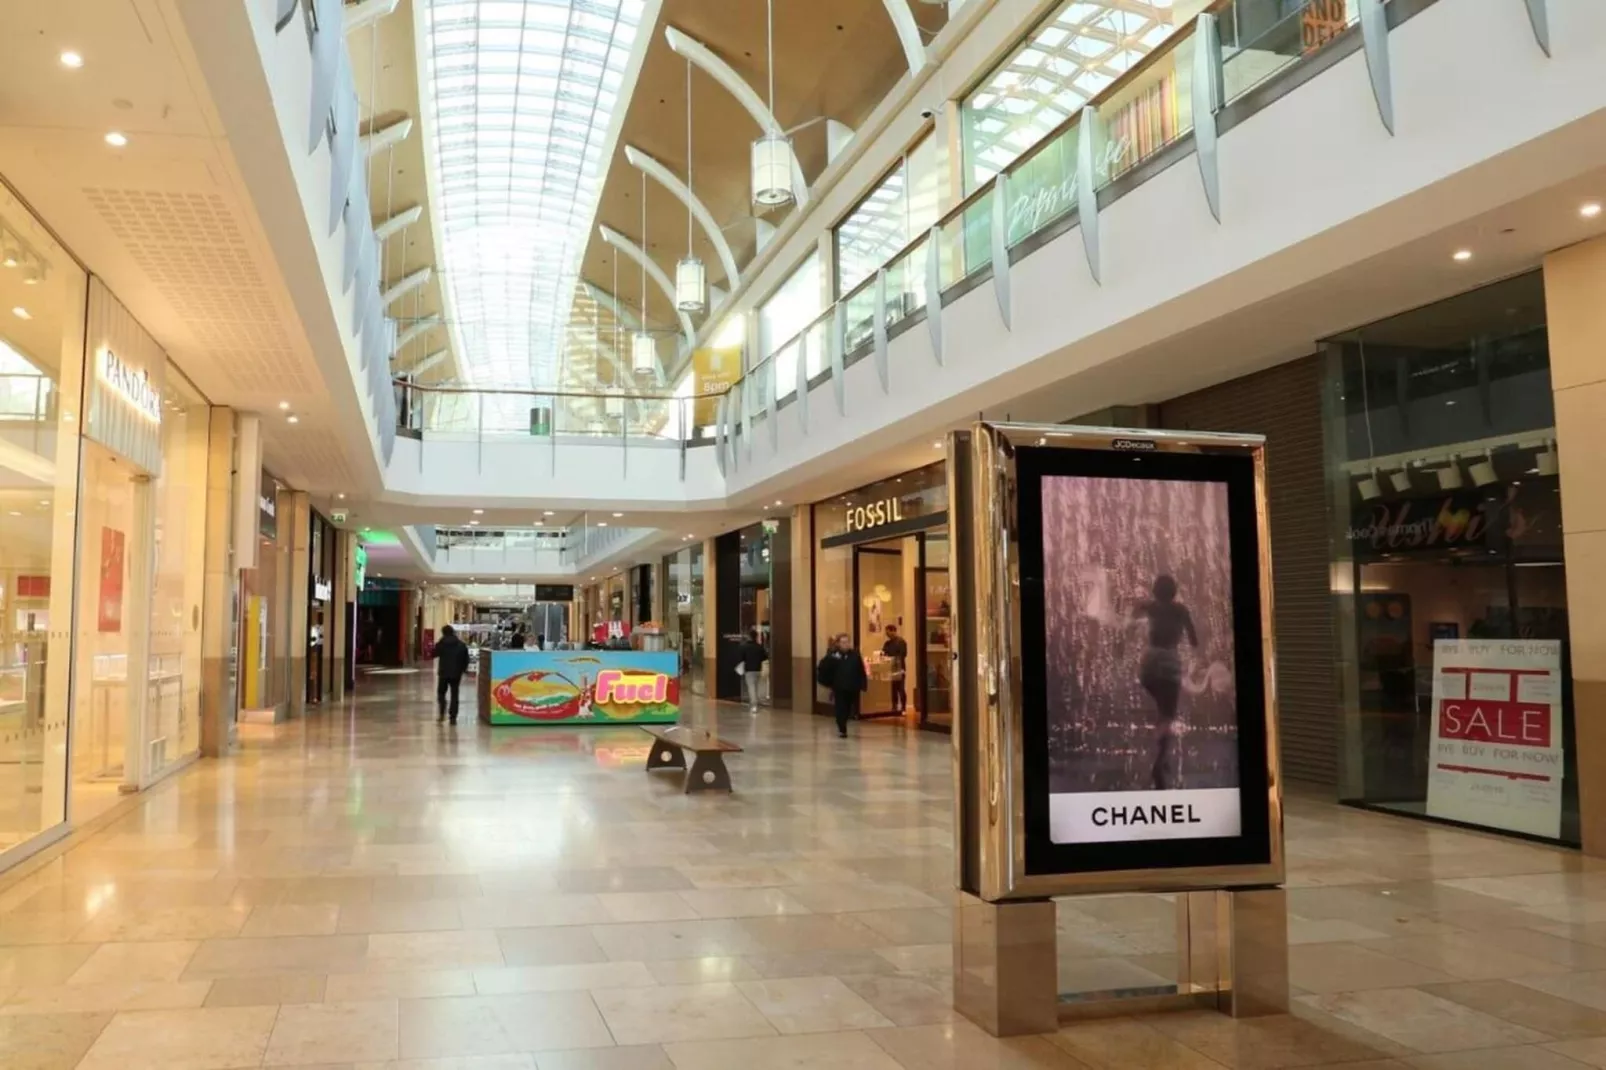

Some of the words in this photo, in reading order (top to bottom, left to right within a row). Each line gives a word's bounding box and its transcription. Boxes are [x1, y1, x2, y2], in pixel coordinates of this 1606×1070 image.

[846, 497, 902, 533] FOSSIL
[595, 669, 668, 704] Fuel
[1446, 705, 1543, 740] SALE
[1091, 804, 1201, 826] CHANEL
